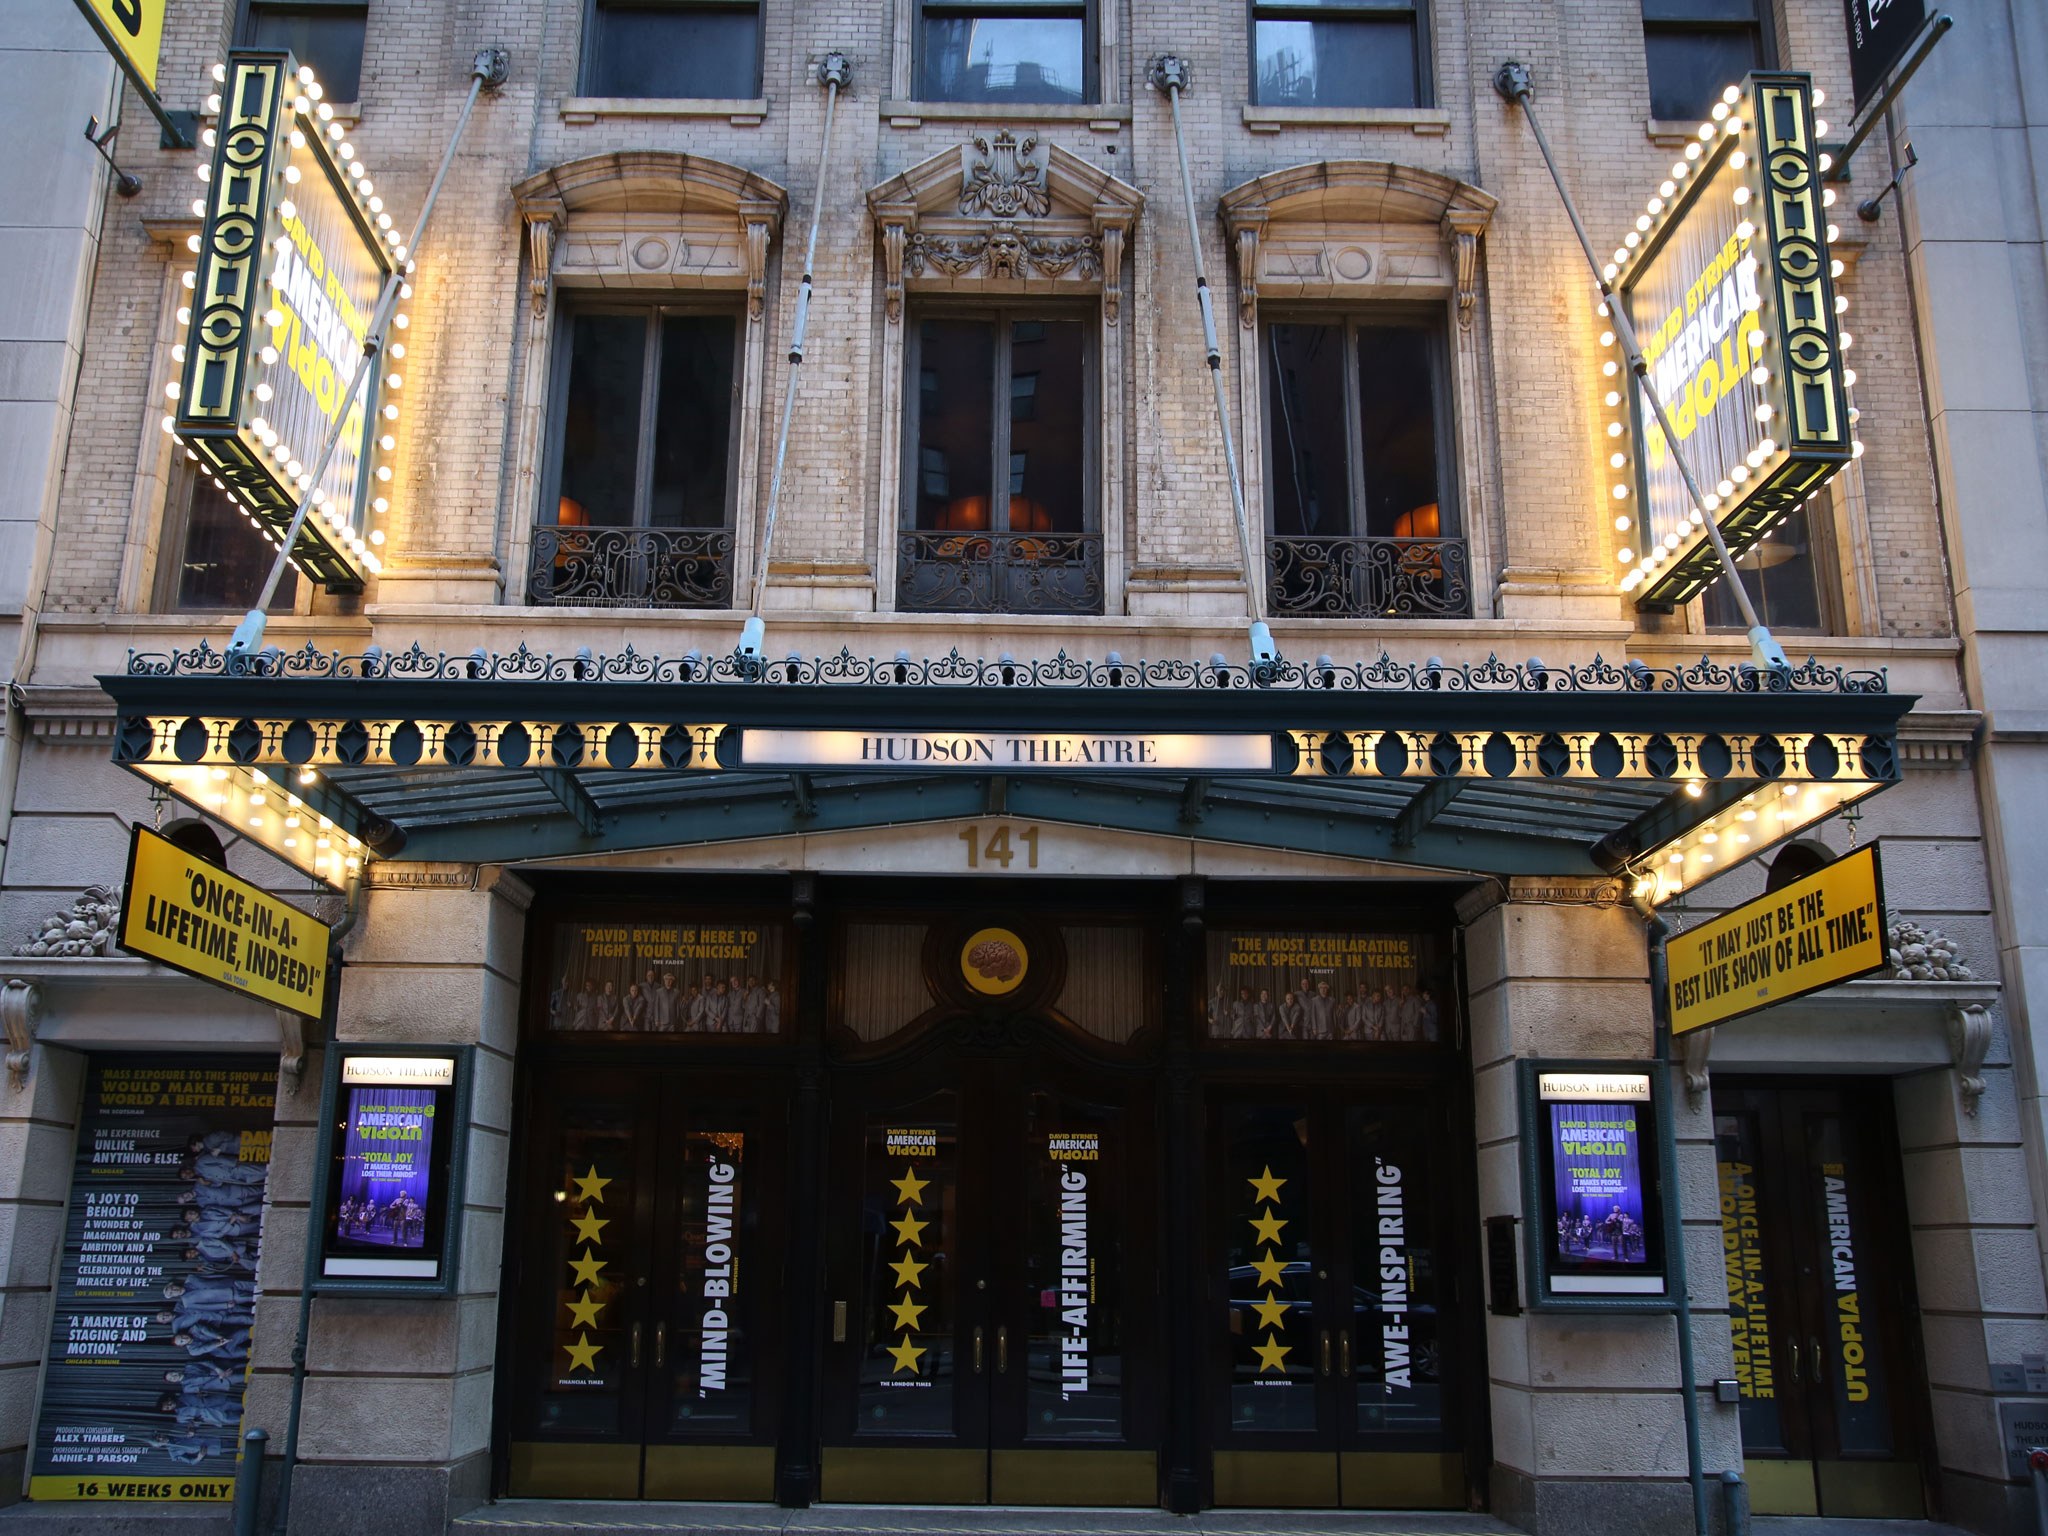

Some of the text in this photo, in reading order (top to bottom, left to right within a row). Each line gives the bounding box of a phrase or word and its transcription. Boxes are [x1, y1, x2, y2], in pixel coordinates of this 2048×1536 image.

[861, 737, 1157, 763] HUDSON THEATRE
[958, 825, 1038, 868] 141
[185, 868, 297, 949] "ONCE-IN-A-
[1717, 926, 1741, 960] MAY
[1746, 912, 1773, 948] JUST
[1778, 903, 1795, 934] BE
[1798, 889, 1824, 925] THE
[581, 928, 758, 944] "DAVID BYRNE IS HERE TO
[145, 895, 321, 997] LIFETIME, INDEED!"
[1231, 937, 1409, 953] "THE MOST EXHILARATING
[591, 944, 751, 959] FIGHT YOUR CYNICISM."
[1674, 902, 1874, 1011] BEST LIVE SHOW OF ALL TIME."
[1229, 952, 1417, 968] ROCK SPECTACLE IN YEARS."
[133, 1070, 186, 1080] EXPOSURE
[189, 1070, 202, 1080] TO
[205, 1071, 227, 1081] THIS
[229, 1072, 259, 1082] SHOW
[346, 1066, 450, 1078] HUDSON THEATRE
[102, 1081, 249, 1094] WOULD MAKE THE
[1543, 1083, 1646, 1093] HUDSON THEATRE
[100, 1094, 154, 1106] WORLD
[159, 1095, 171, 1106] A
[175, 1095, 225, 1106] BETTER
[359, 1113, 422, 1126] AMERICAN
[110, 1129, 160, 1138] EXPERIENCE
[240, 1131, 273, 1146] DAV
[359, 1126, 422, 1140] UTOPIA
[1561, 1129, 1624, 1141] AMERICAN
[95, 1140, 135, 1151] UNLIKE
[887, 1135, 936, 1146] AMERICAN
[1049, 1140, 1098, 1149] AMERICAN
[888, 1146, 936, 1156] UTOPIA
[1562, 1142, 1627, 1155] UTOPIA
[92, 1152, 184, 1164] ANYTHING ELSE."
[394, 1152, 414, 1163] JOY.
[1049, 1150, 1098, 1160] UTOPIA
[1603, 1168, 1622, 1178] JOY.
[85, 1193, 139, 1205] "A JOY TO
[86, 1206, 134, 1217] BEHOLD!
[84, 1220, 143, 1229] A WONDER OF
[83, 1231, 161, 1241] IMAGINATION AND
[1823, 1176, 1858, 1291] AMERICAN
[81, 1243, 153, 1252] AMBITION AND A
[79, 1254, 145, 1263] BREATHTAKING
[78, 1266, 162, 1276] CELEBRATION OF THE
[700, 1154, 735, 1398] "MIND-BLOWING"
[1375, 1156, 1411, 1394] "AWE-INSPIRING"
[76, 1277, 153, 1287] MIRACLE OF LIFE."
[1061, 1164, 1088, 1401] "LIFE-AFFIRMING"
[1717, 1162, 1754, 1398] BROADWAY EVENT
[1734, 1162, 1775, 1400] A ONCE-IN-A-LIFETIME
[68, 1315, 148, 1328] "A MARVEL OF
[69, 1329, 147, 1341] STAGING AND
[67, 1342, 122, 1355] MOTION."
[1837, 1292, 1869, 1402] UTOPIA
[2014, 1420, 2048, 1431] HUDSO
[55, 1434, 125, 1443] ALEX TIMBERS
[51, 1454, 138, 1463] ANNIE-B PARSON
[77, 1483, 231, 1498] 16 WEEKS ONLY
